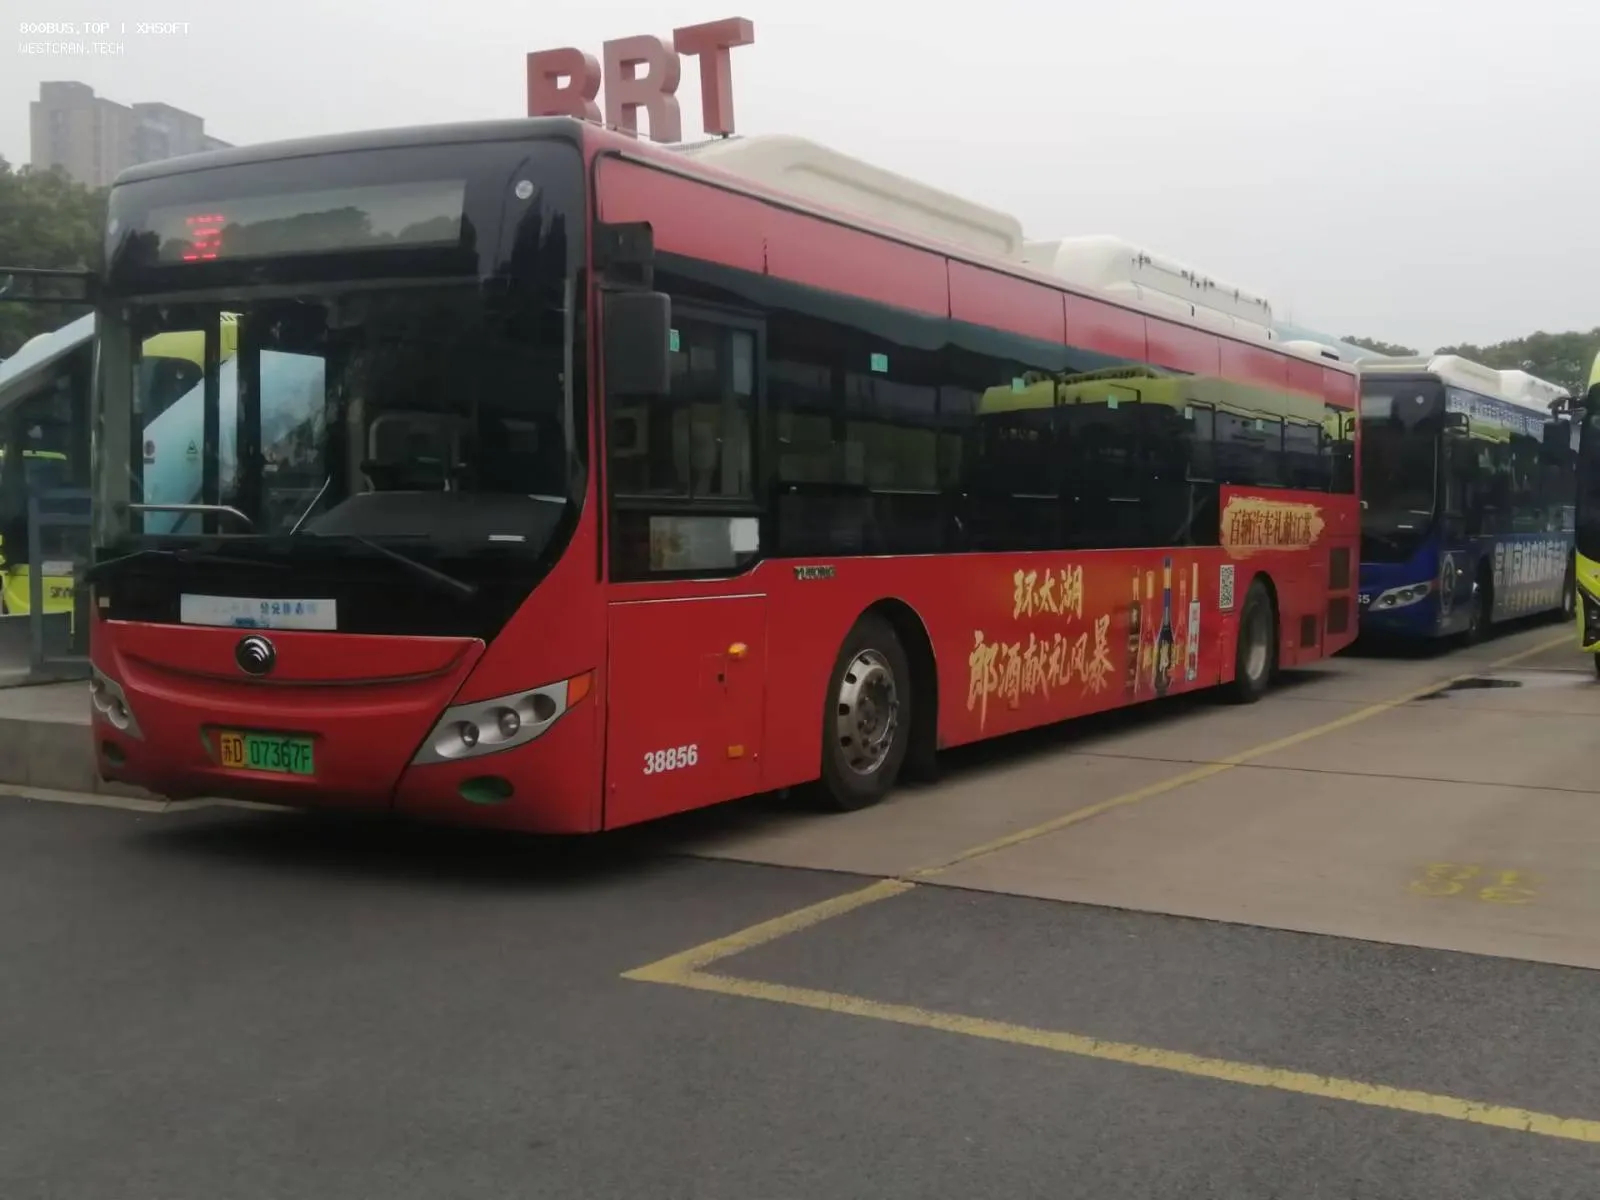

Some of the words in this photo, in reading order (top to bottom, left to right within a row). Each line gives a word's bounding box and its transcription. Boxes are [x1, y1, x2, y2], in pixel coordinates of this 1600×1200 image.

[527, 16, 755, 144] BRT
[1013, 564, 1084, 624] 环太湖
[643, 743, 699, 775] 38856
